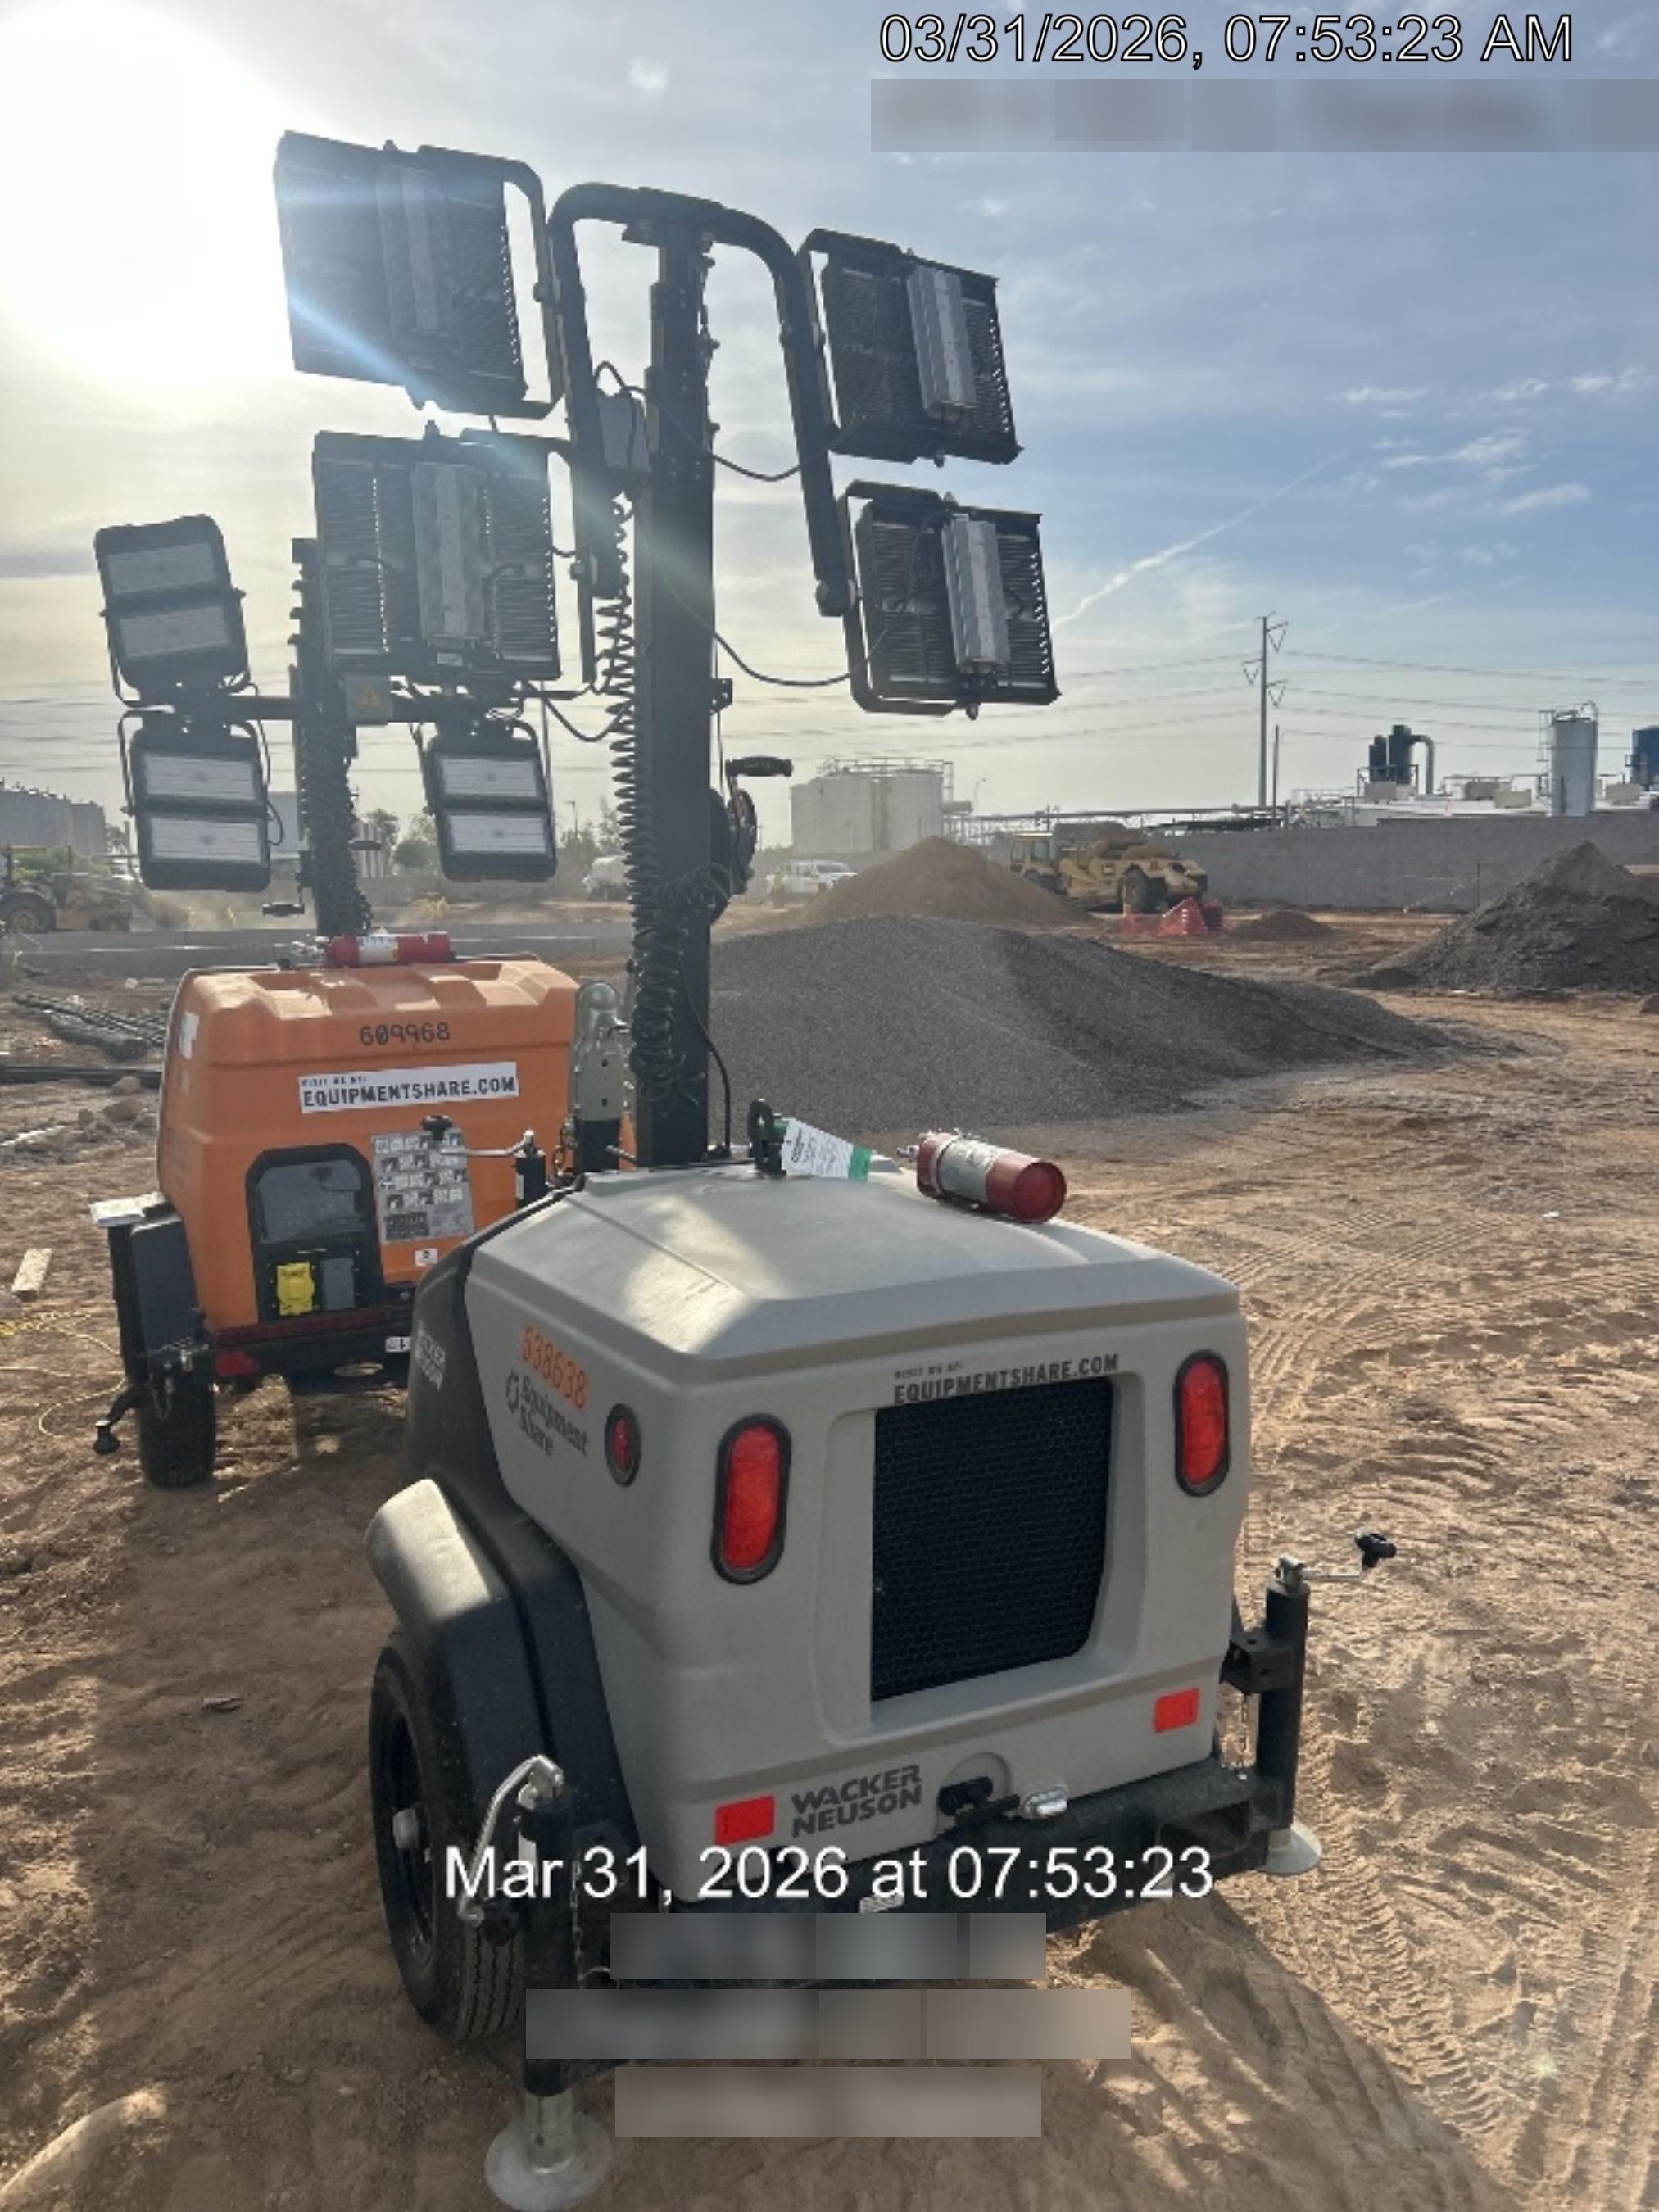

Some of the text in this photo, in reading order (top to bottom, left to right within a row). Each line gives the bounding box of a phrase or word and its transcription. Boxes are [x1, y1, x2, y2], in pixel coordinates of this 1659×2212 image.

[360, 1022, 451, 1045] 609968
[302, 1076, 517, 1107] EQUIPMENTSHARE.COM
[522, 1326, 587, 1410] 538638
[894, 1353, 1118, 1404] EQUIPMENTSHARE.COM
[791, 1764, 922, 1814] WACKER
[792, 1784, 922, 1838] NEUSON
